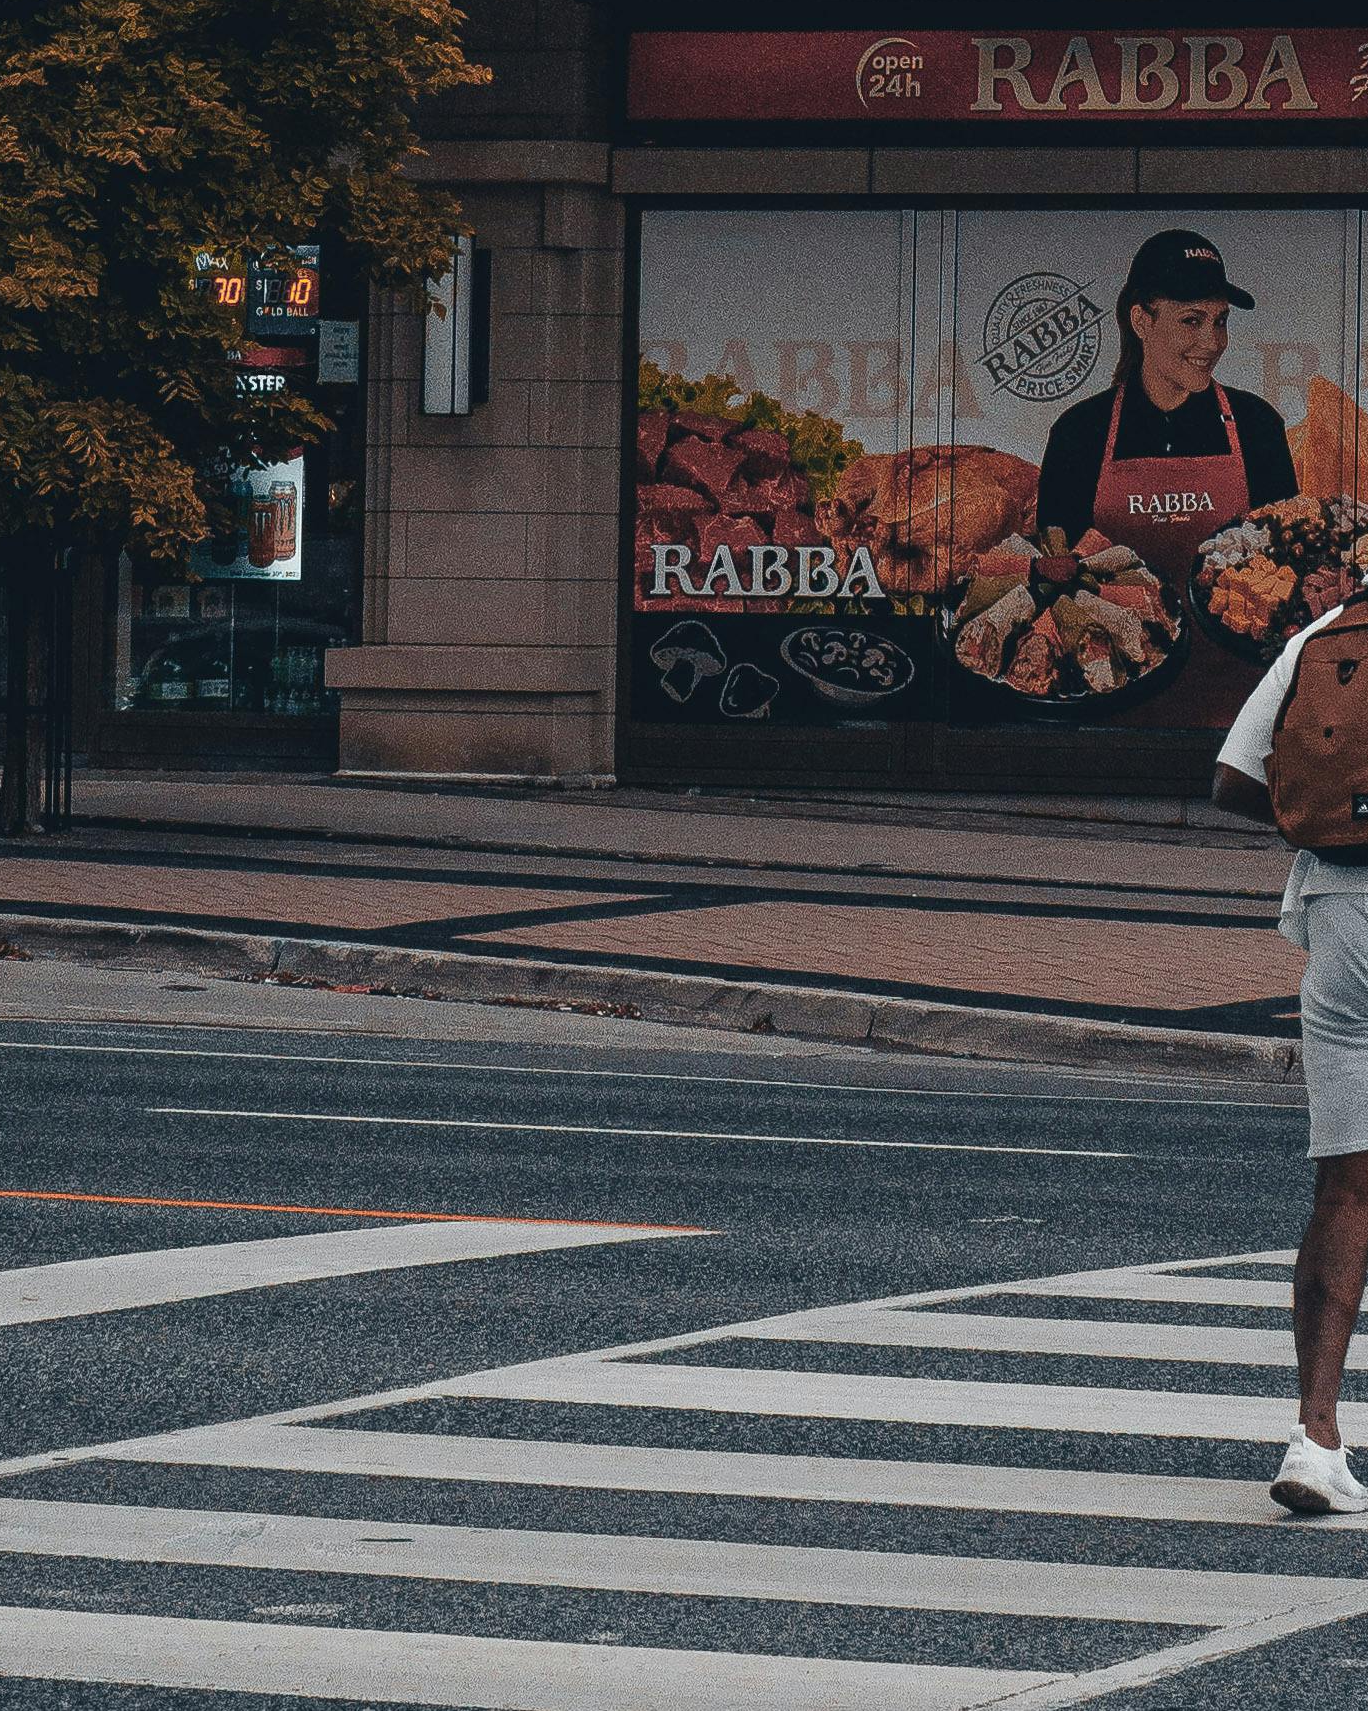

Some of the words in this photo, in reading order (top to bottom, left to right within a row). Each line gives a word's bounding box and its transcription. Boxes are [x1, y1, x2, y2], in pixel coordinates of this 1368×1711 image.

[872, 55, 924, 75] open
[970, 34, 1320, 112] RABBA
[869, 73, 921, 98] 24h
[1015, 279, 1072, 298] FRESHNESS
[982, 294, 1104, 386] RABBA
[1015, 378, 1064, 397] PRICE
[1065, 332, 1097, 386] SMART
[1127, 492, 1215, 514] RABBA
[650, 544, 885, 598] RABBA
